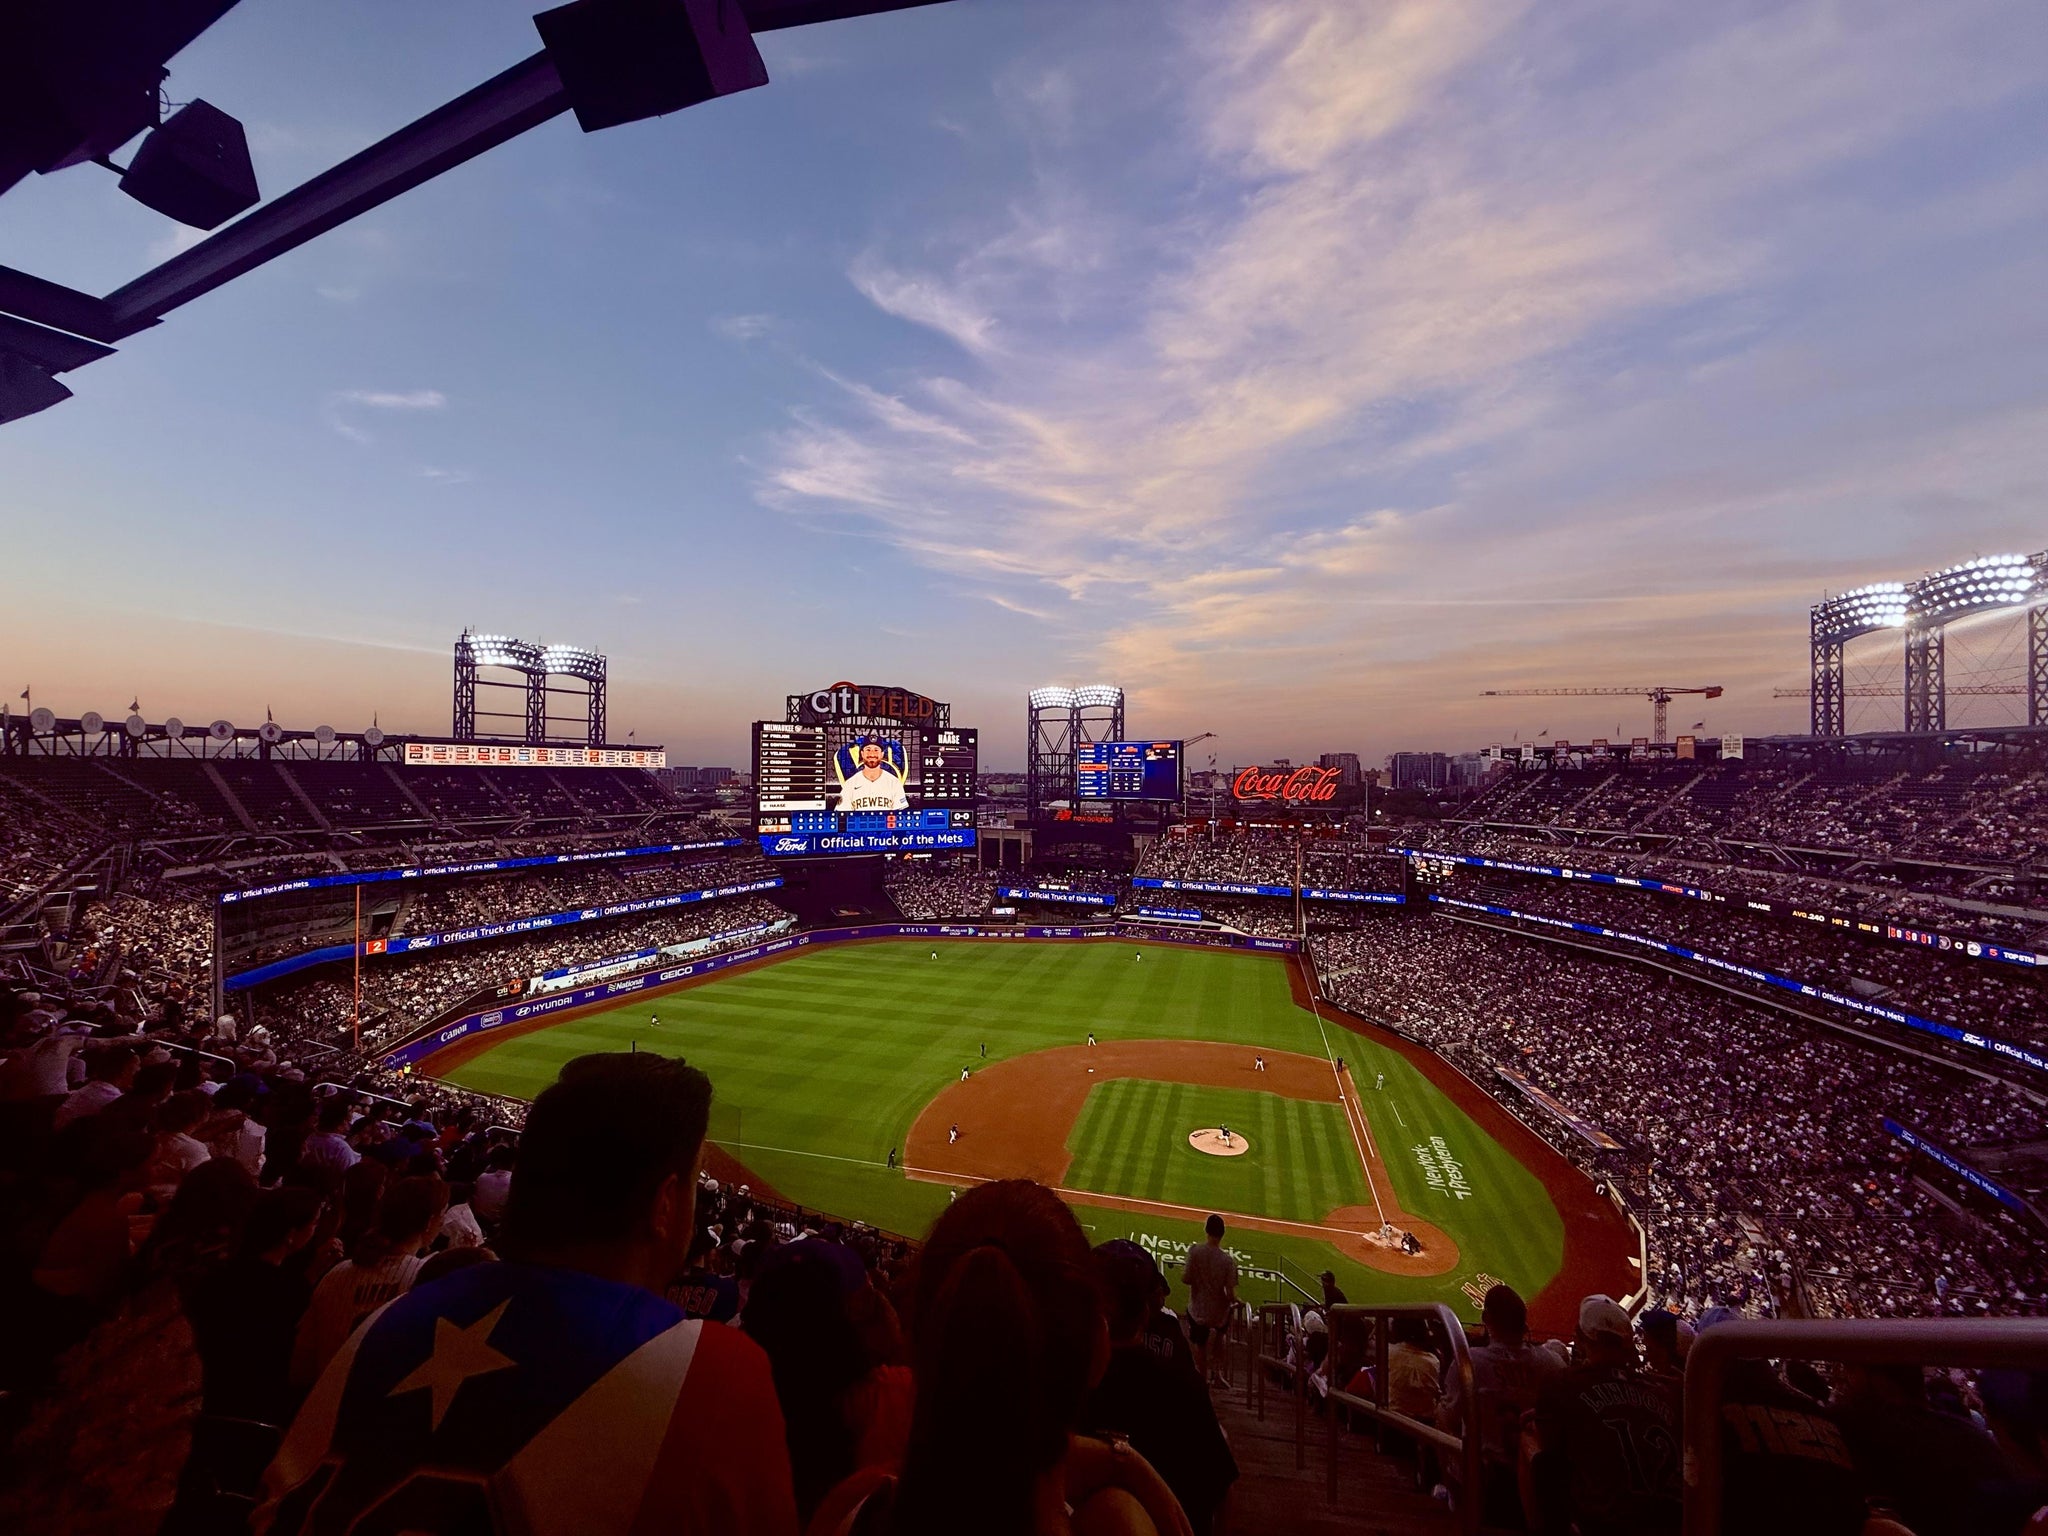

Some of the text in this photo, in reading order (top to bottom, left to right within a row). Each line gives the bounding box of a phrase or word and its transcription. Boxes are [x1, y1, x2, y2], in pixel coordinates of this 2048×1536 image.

[812, 687, 934, 716] citi FIELD
[938, 734, 960, 744] HAASE
[1233, 766, 1342, 800] Coca-Cola
[776, 834, 963, 851] Ford Official Truck of the Mets
[223, 894, 237, 902] Ford
[243, 889, 262, 897] Official
[263, 886, 277, 894] Truck
[701, 891, 714, 899] Ford
[719, 888, 736, 896] Official
[737, 885, 750, 893] Truck
[580, 896, 681, 920] Ford Official Truck of the Mets
[1792, 910, 1825, 922] AVG .240
[408, 918, 552, 949] Ford Official Truck of the Mets
[798, 937, 810, 945] citi
[373, 942, 382, 951] 2
[1255, 940, 1283, 948] Heineken
[1989, 948, 1998, 956] 5
[660, 966, 693, 980] GEICO
[616, 977, 644, 990] National
[532, 996, 573, 1012] HYUNDAI
[1801, 985, 1816, 995] Ford
[1822, 992, 1844, 1004] Official
[1846, 999, 1863, 1010] Truck
[1874, 1008, 1885, 1016] the
[1887, 1012, 1905, 1022] Mets
[440, 1024, 467, 1042] Canon
[1963, 1033, 2042, 1067] Ford Official Truck
